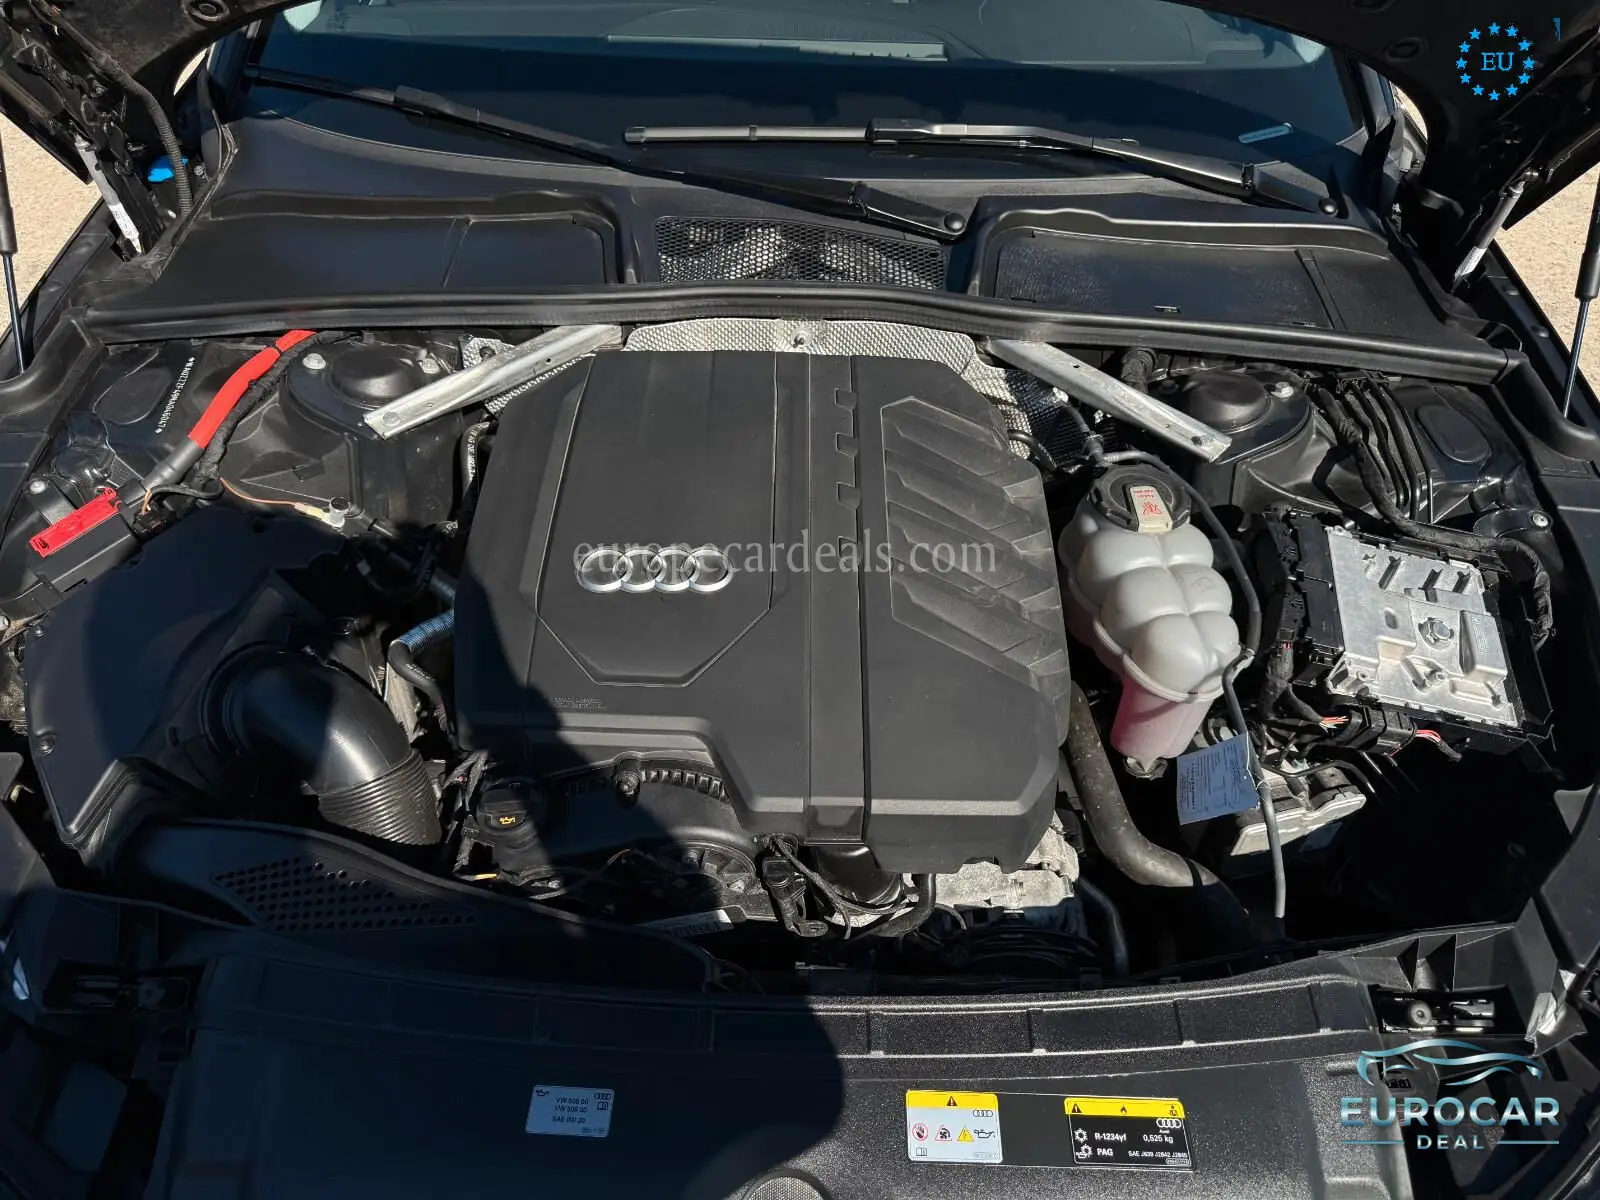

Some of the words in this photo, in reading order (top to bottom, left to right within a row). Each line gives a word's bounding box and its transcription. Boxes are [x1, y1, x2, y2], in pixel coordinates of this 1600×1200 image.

[1094, 1132, 1127, 1143] R-1234yf
[1143, 1134, 1163, 1142] 0,525
[1164, 1135, 1174, 1144] kg
[1097, 1148, 1114, 1156] PAG
